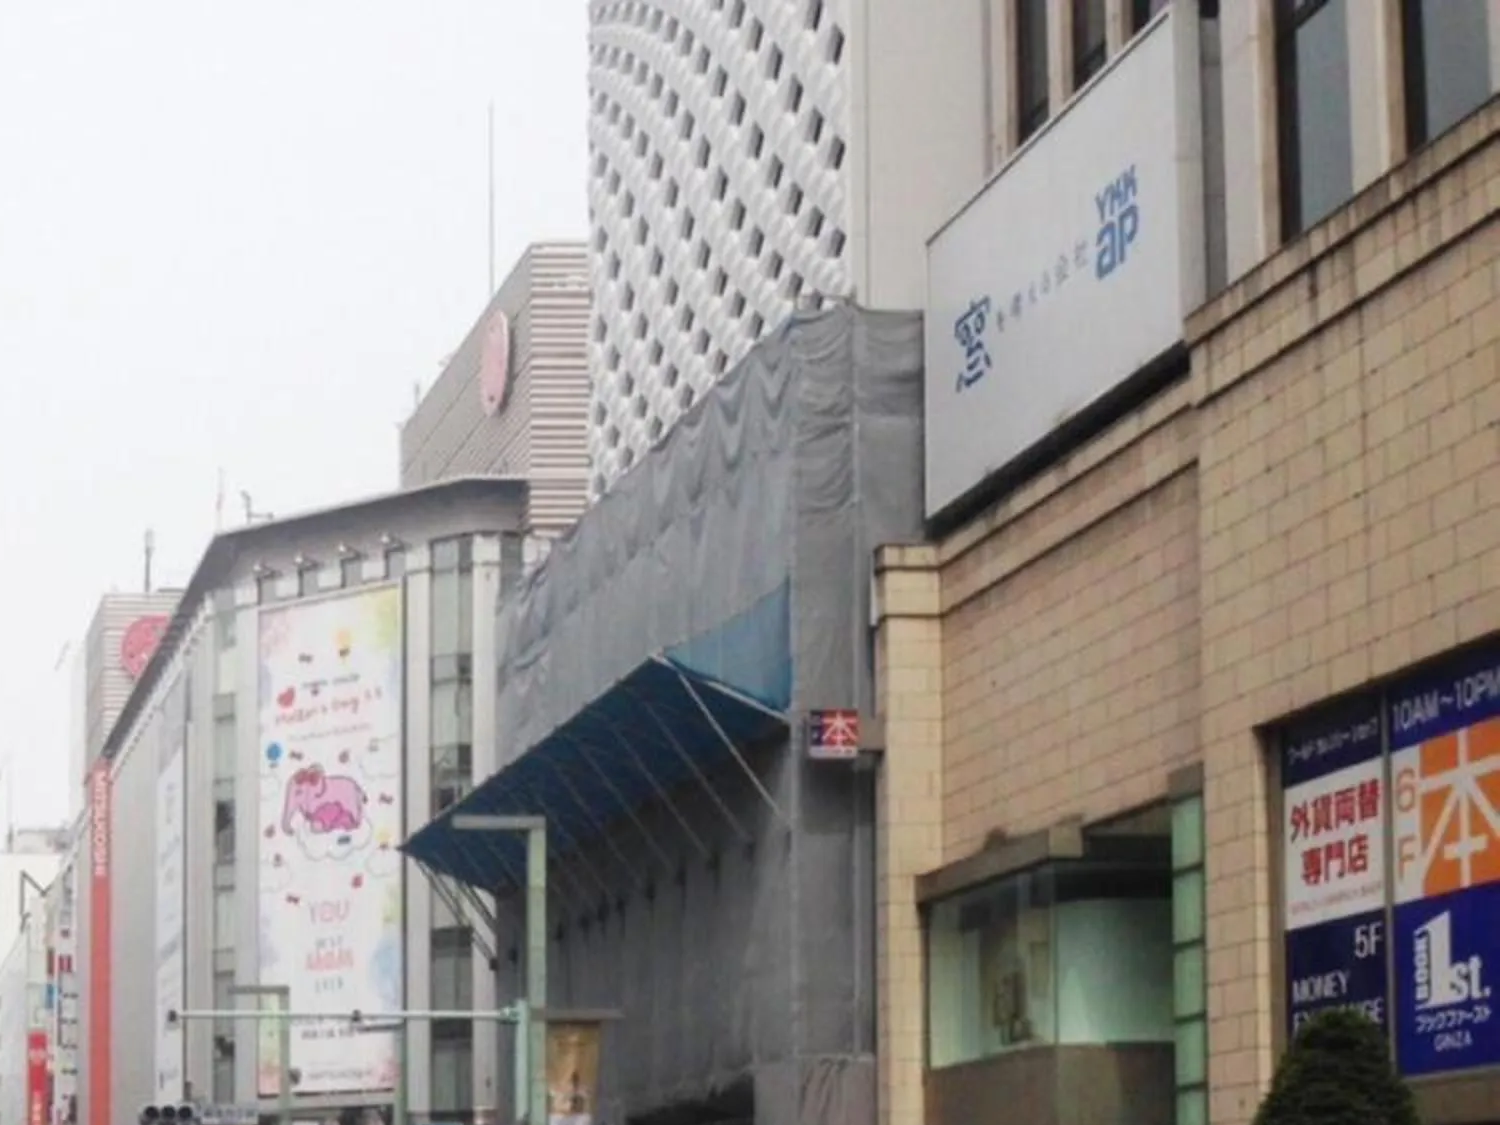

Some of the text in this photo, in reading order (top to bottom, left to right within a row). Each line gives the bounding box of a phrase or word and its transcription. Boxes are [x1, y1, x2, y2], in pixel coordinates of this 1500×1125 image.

[1095, 164, 1138, 224] YKK
[1096, 204, 1140, 280] ap
[1290, 778, 1380, 843] 外貨両替
[1302, 834, 1369, 887] 専門店
[1354, 922, 1384, 960] 5F
[1292, 969, 1349, 1005] MONEY
